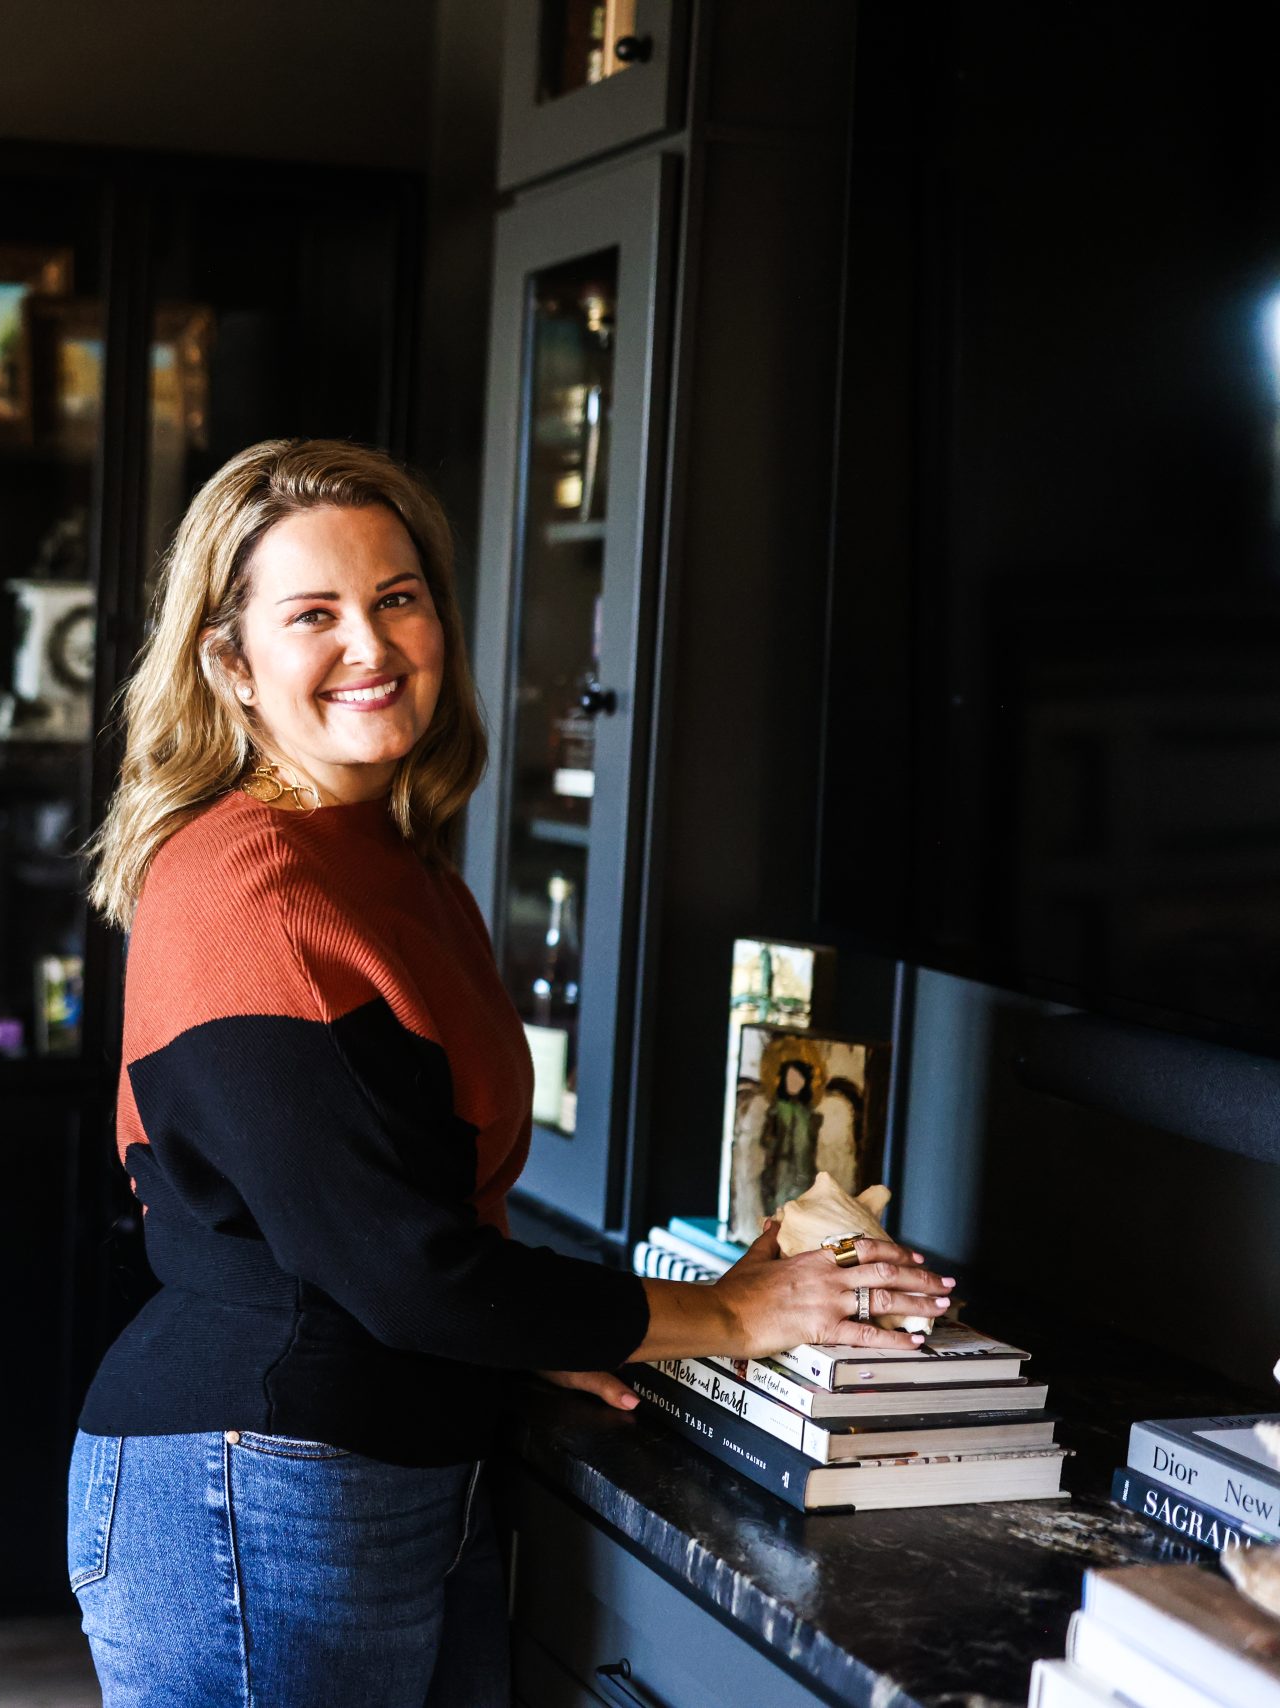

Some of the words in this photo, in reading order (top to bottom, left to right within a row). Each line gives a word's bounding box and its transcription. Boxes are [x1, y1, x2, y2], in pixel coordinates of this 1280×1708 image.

[698, 1379, 711, 1393] and
[711, 1376, 749, 1416] Boards
[753, 1368, 768, 1385] Just
[633, 1381, 681, 1418] MAGNOLIA
[684, 1412, 714, 1438] TABLE
[722, 1437, 745, 1456] JOANNA
[745, 1452, 767, 1470] GAINES
[1122, 1479, 1130, 1501] ENGLISH
[1152, 1444, 1198, 1486] Dior
[1224, 1478, 1273, 1520] New
[1143, 1489, 1252, 1552] SAGRAD
